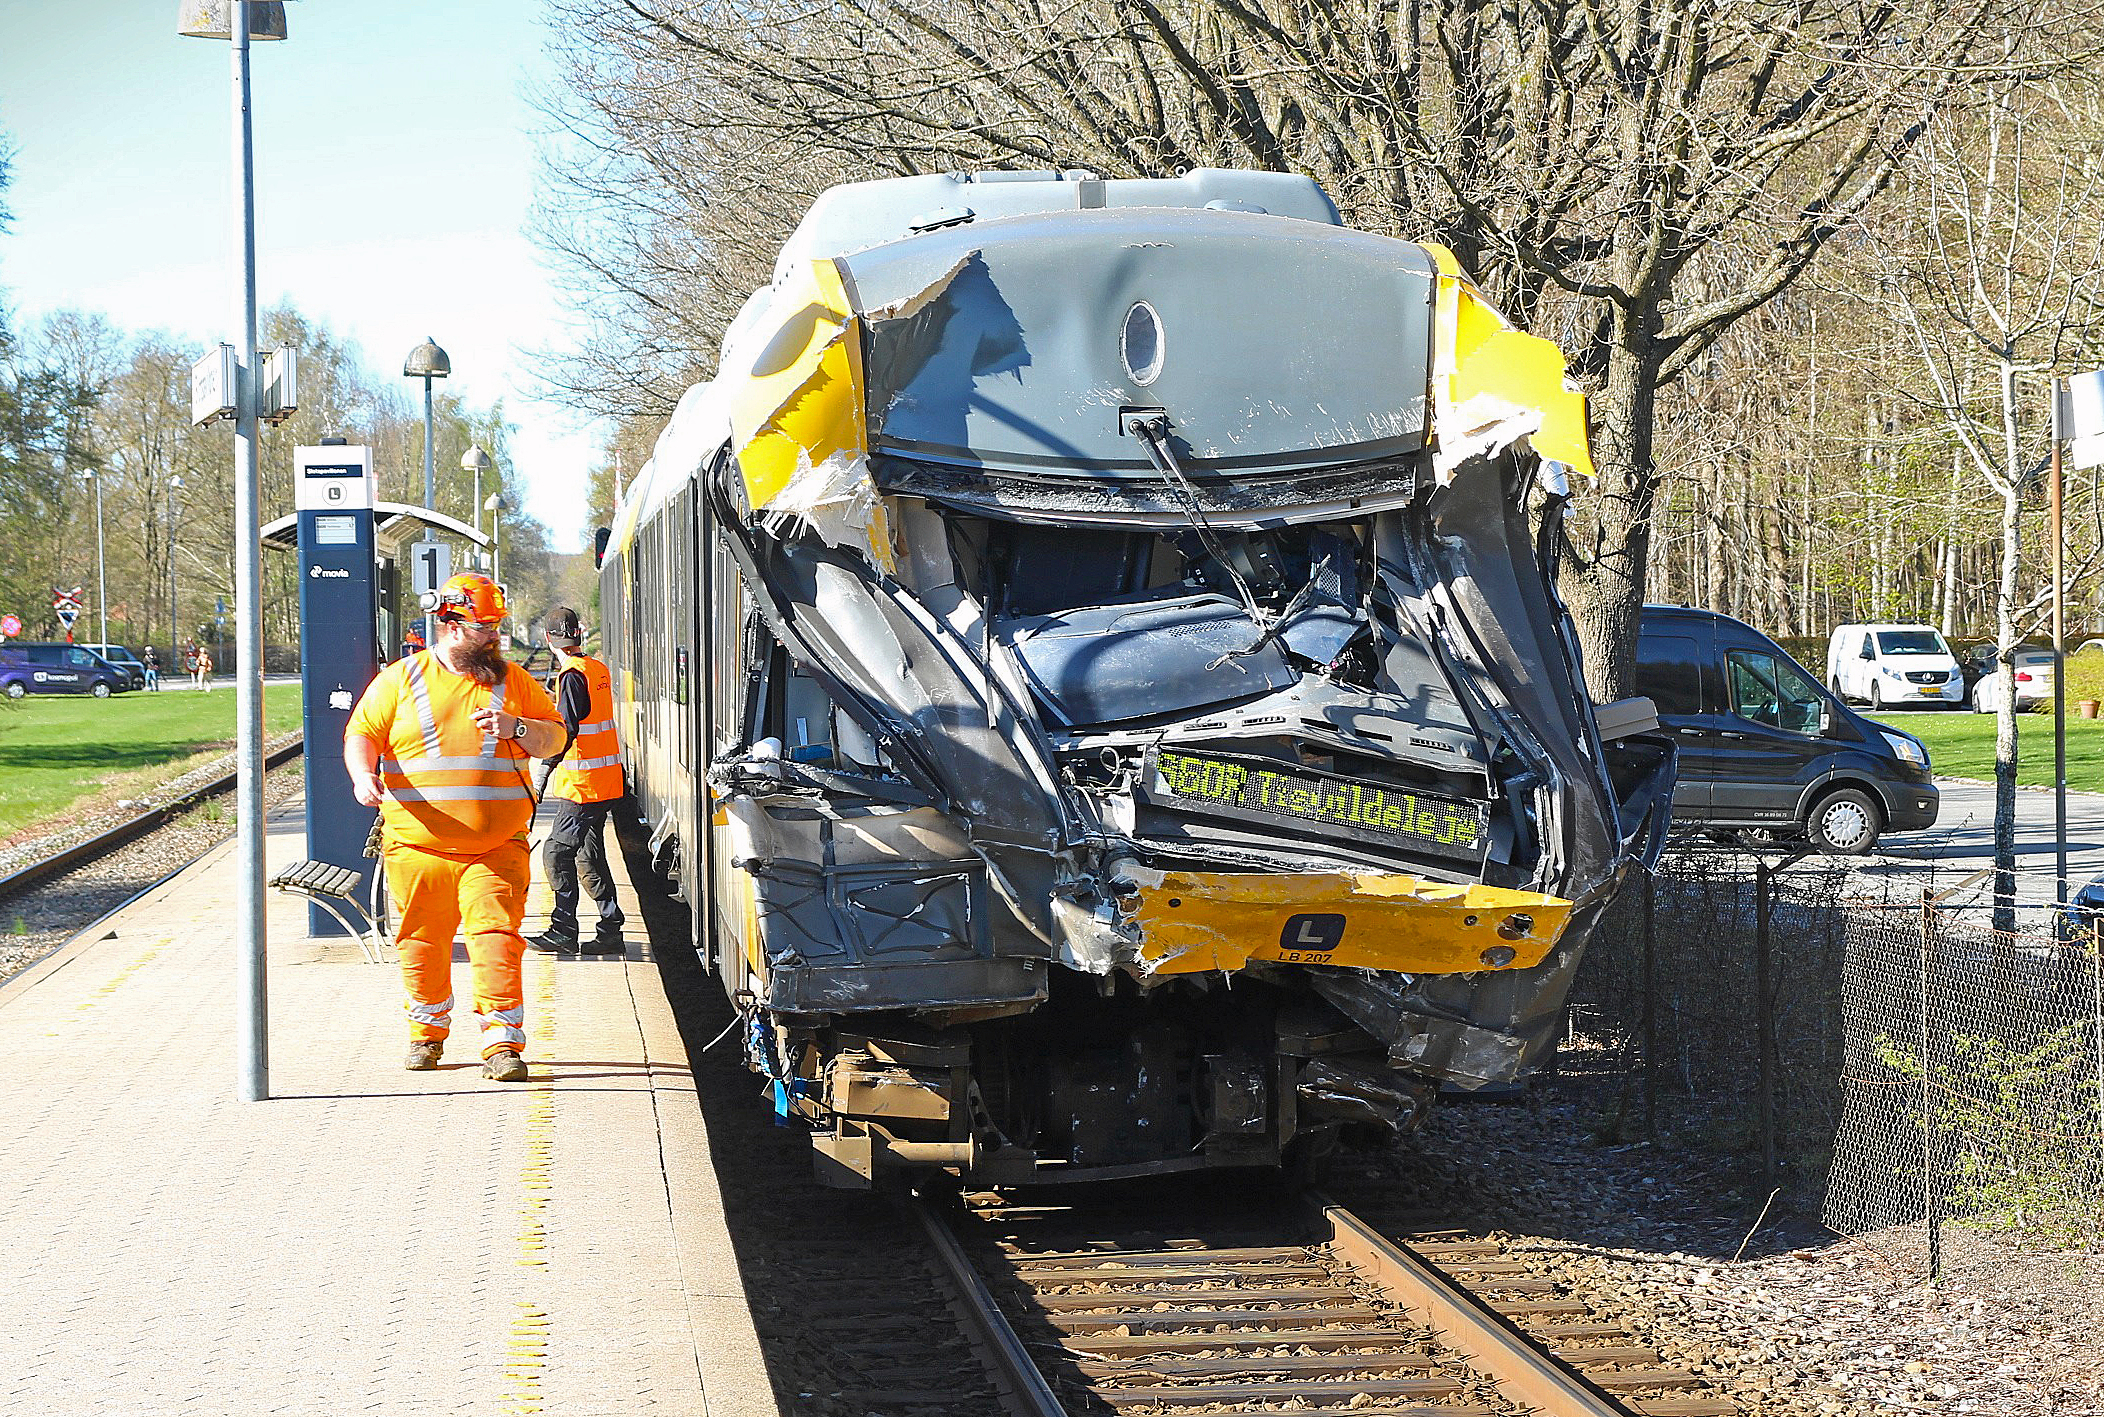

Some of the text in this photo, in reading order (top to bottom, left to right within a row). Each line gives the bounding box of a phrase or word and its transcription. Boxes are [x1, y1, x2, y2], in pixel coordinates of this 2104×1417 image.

[322, 568, 349, 577] movia
[421, 548, 437, 590] 1
[1297, 920, 1323, 943] L
[1278, 951, 1332, 963] LB 207
